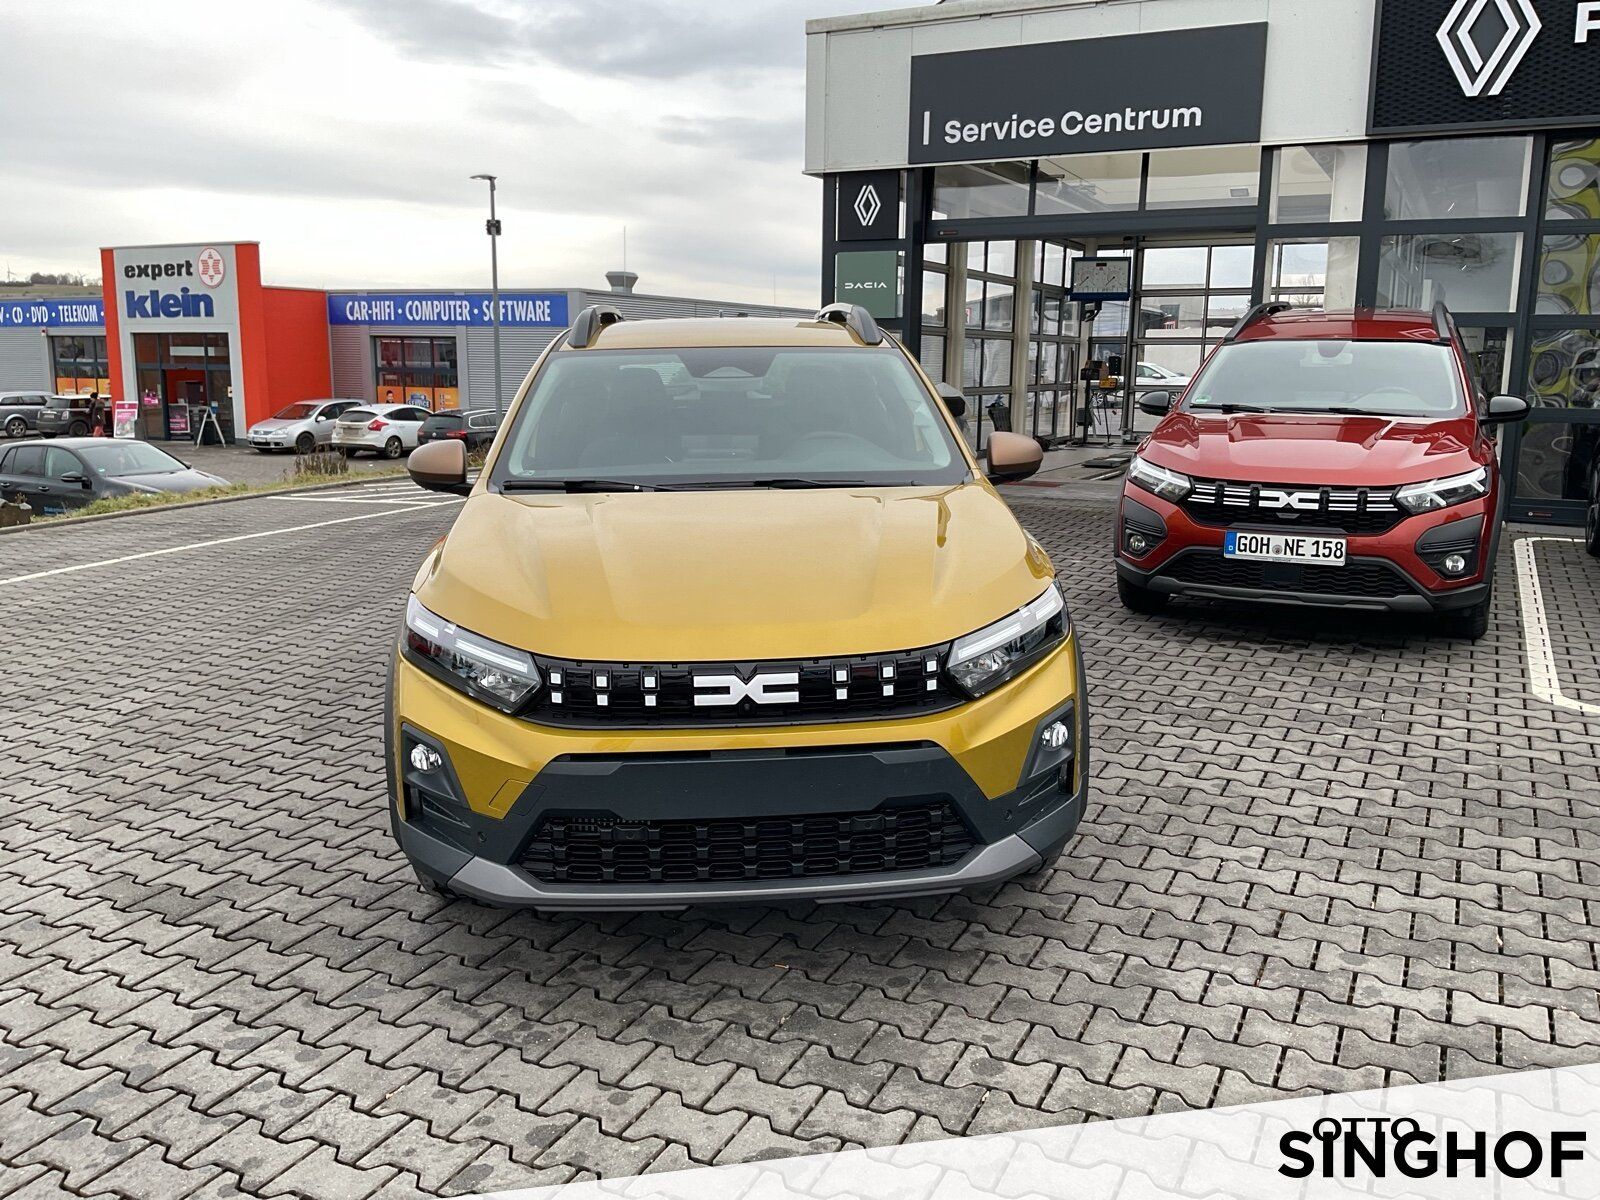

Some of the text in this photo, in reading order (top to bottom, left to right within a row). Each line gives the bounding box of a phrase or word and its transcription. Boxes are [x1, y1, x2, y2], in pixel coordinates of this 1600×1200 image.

[944, 106, 1202, 144] Service Centrum
[124, 260, 193, 281] expert
[12, 306, 23, 323] CD
[31, 306, 48, 323] DVD
[58, 304, 98, 322] TELEKOM
[125, 287, 214, 318] klein
[346, 300, 394, 321] CAR-HIFI
[405, 300, 471, 321] COMPUTER
[1237, 535, 1270, 554] GOH
[1283, 538, 1306, 557] NE
[1311, 540, 1344, 559] 158
